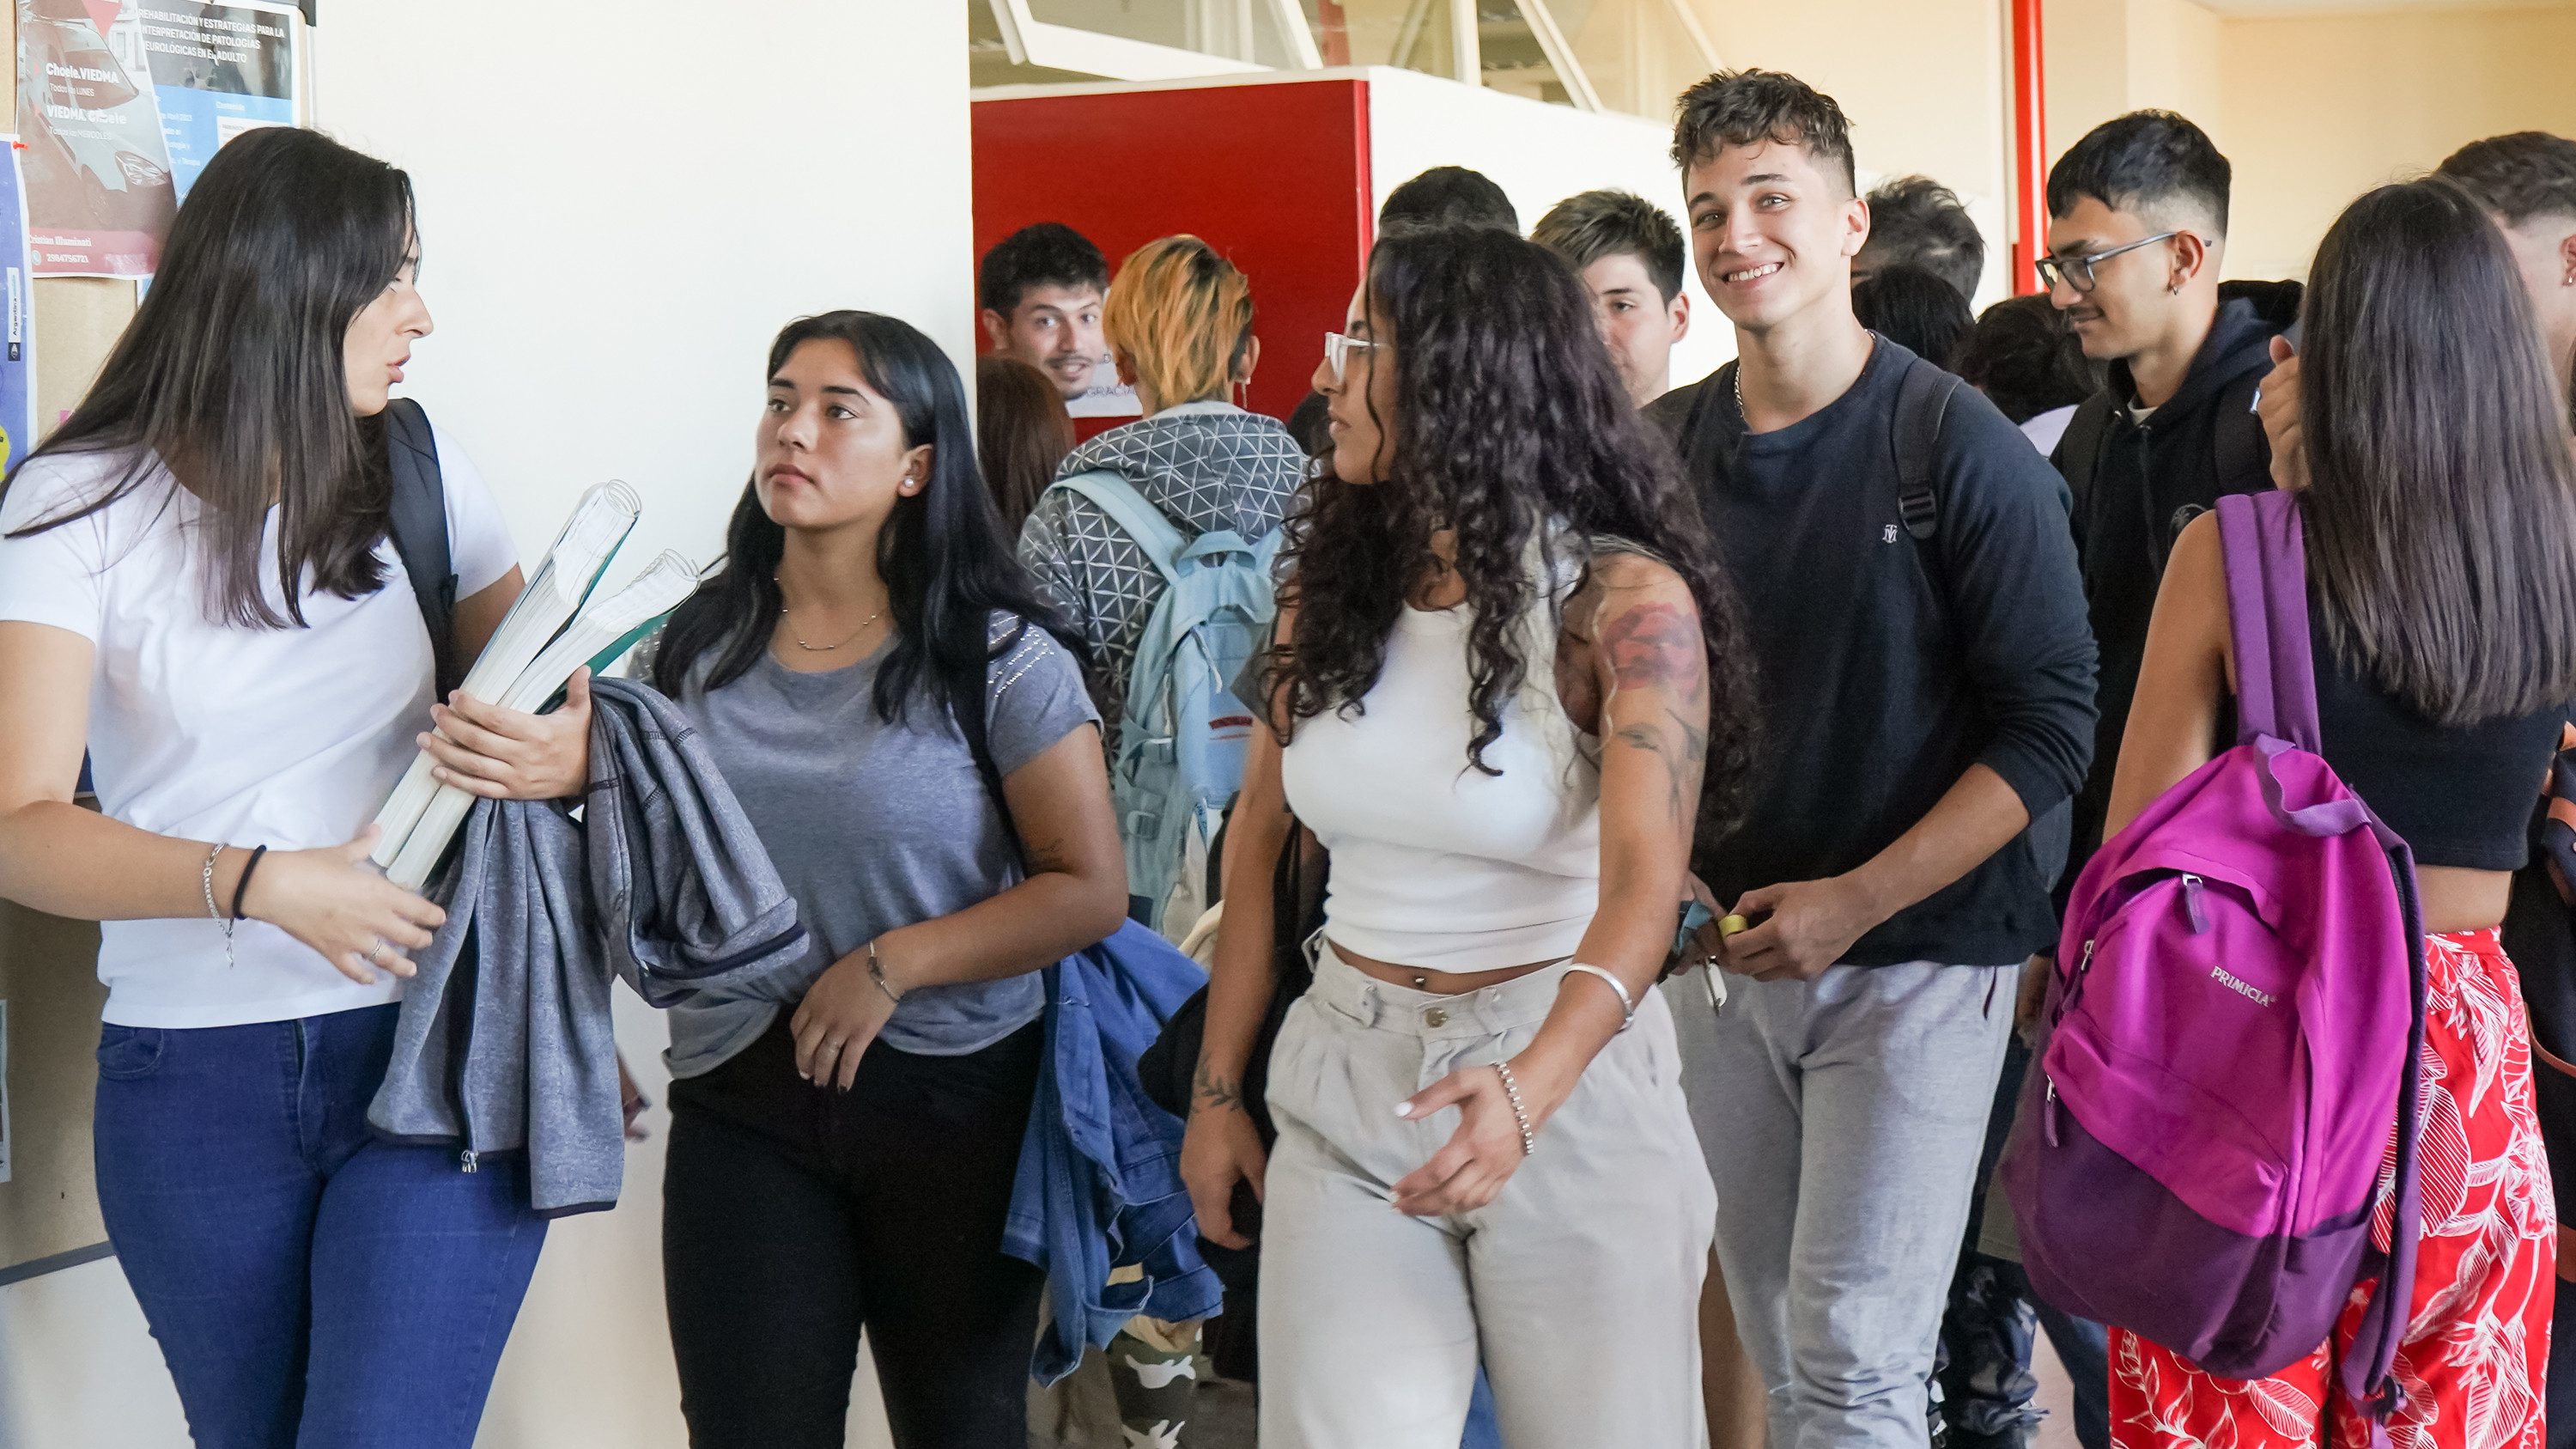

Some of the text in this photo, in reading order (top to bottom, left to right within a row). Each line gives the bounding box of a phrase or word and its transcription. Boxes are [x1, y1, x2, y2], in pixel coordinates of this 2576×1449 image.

[139, 9, 285, 38] REHABILITACIÓN Y ESTRATEGIAS PARA LA
[142, 25, 261, 49] NTERPRETACIÓN DE PATOLOGÍAS
[145, 40, 197, 56] EUROLÓGICAS
[197, 48, 207, 58] EN
[217, 51, 246, 64] ADULTO
[76, 87, 94, 96] LUNES
